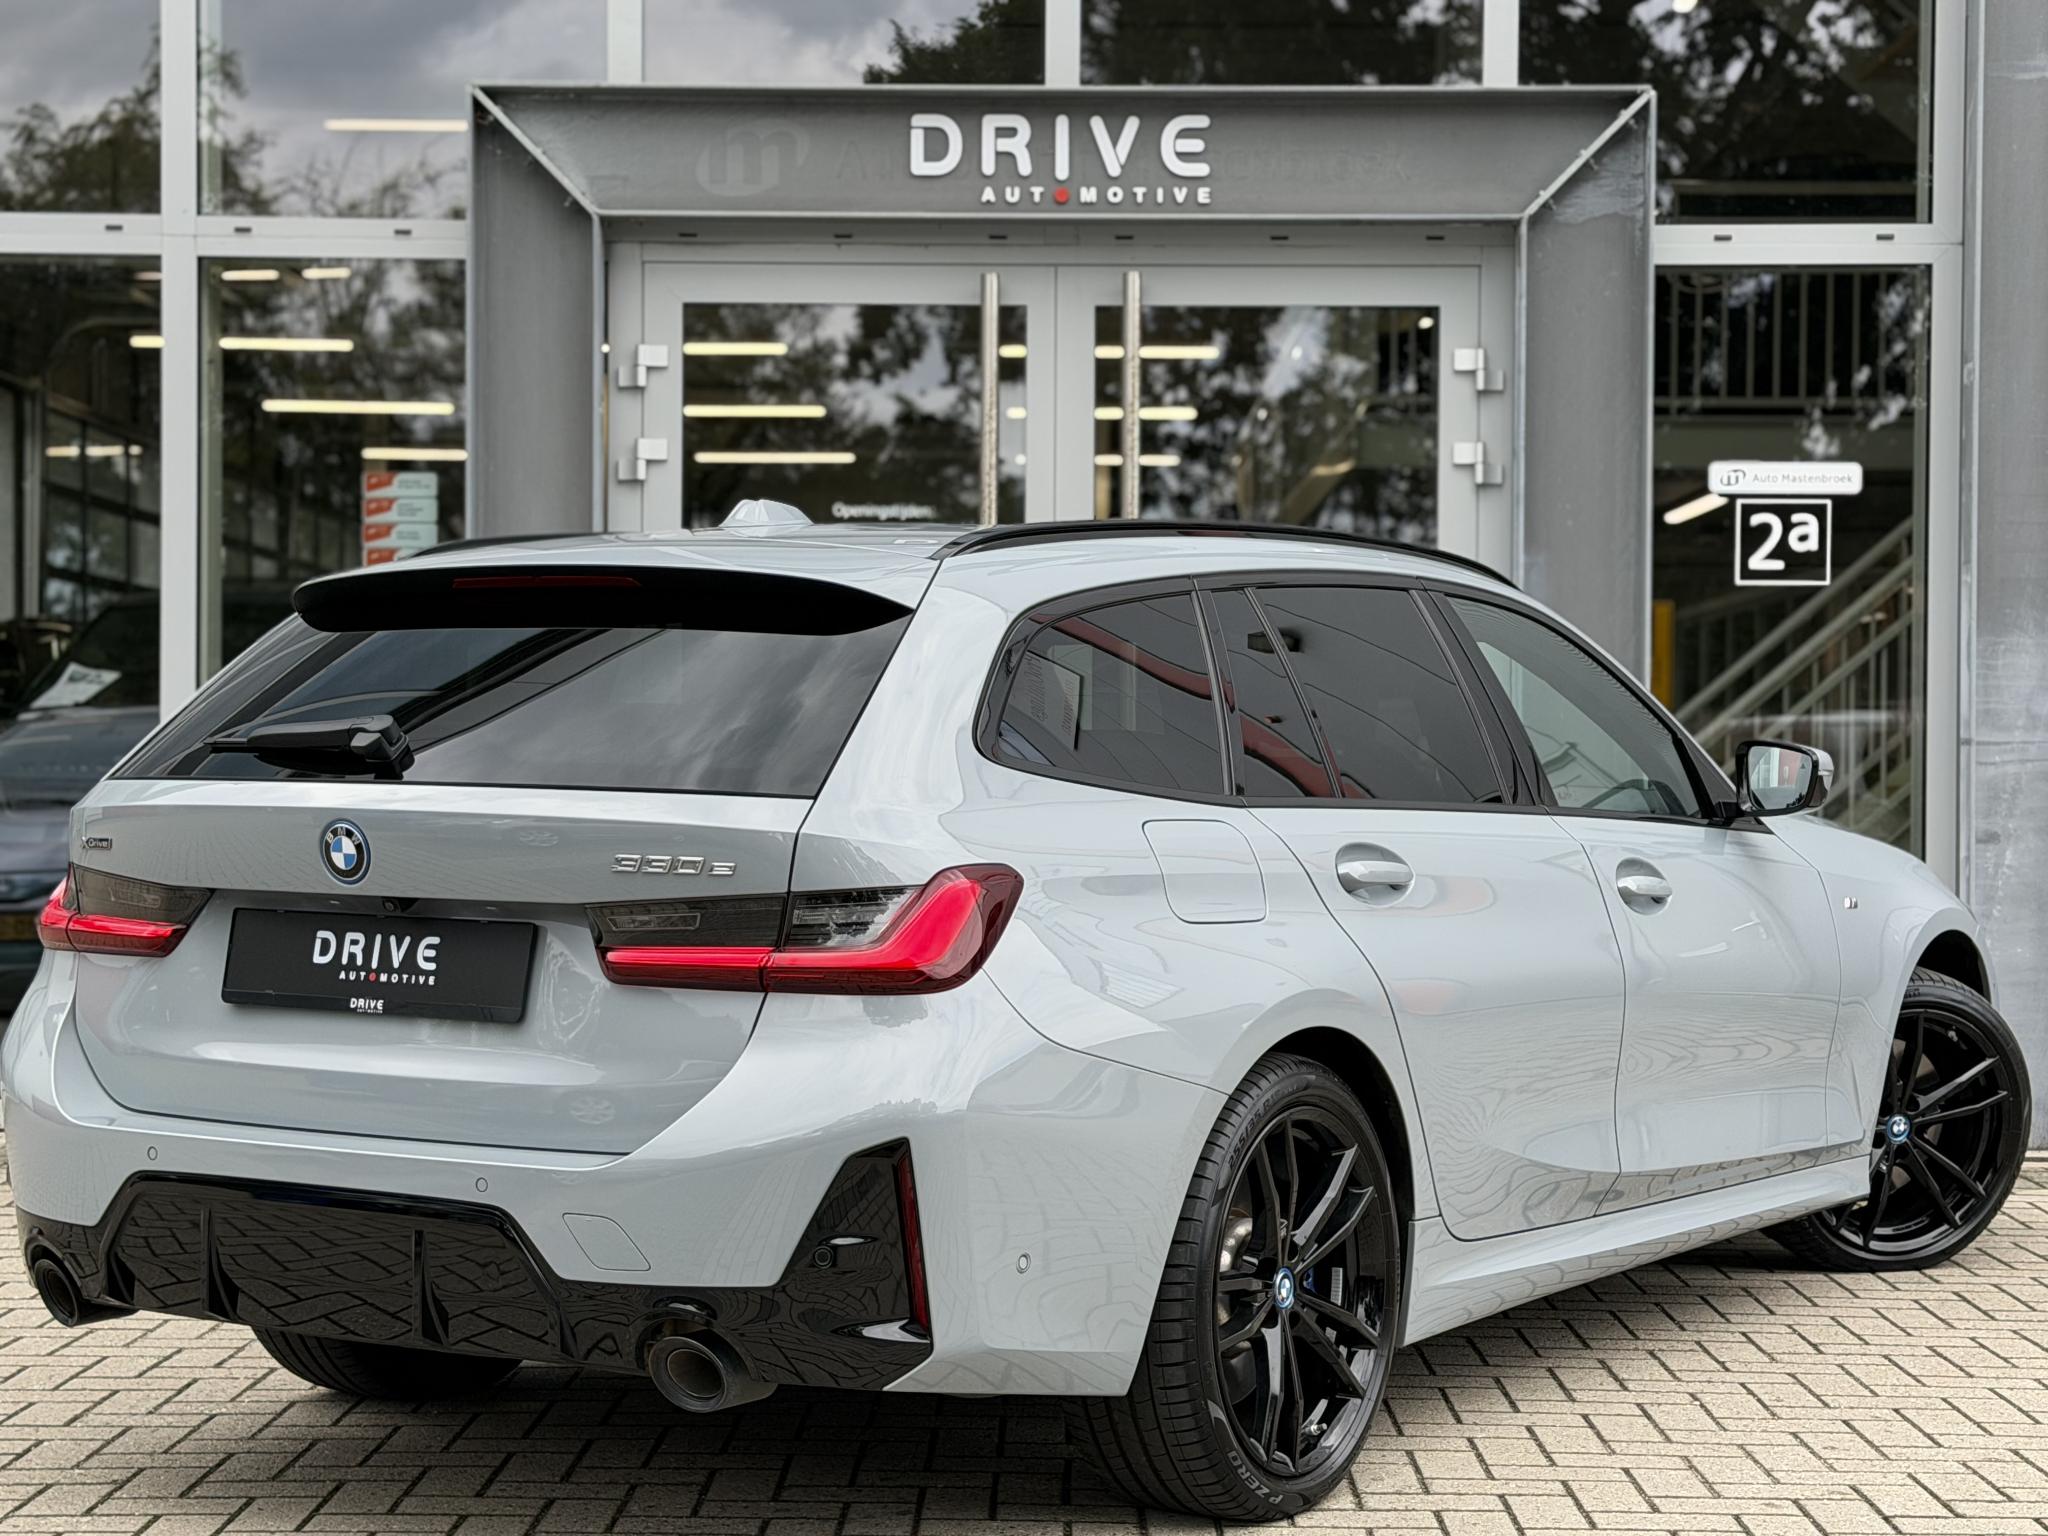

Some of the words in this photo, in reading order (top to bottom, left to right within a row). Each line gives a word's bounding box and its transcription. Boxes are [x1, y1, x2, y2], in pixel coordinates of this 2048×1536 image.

[910, 113, 1212, 181] DRIVE
[980, 186, 1212, 204] AUTOMOTIVE
[1752, 473, 1778, 484] Auto
[1782, 473, 1853, 484] Mastenbroek
[1747, 512, 1820, 571] 2a
[312, 930, 441, 971] DRIVE
[338, 970, 436, 986] AUTOMOTIVE
[350, 997, 384, 1010] DRIVE
[1227, 1450, 1271, 1498] ZERO
[1268, 1494, 1284, 1505] P
